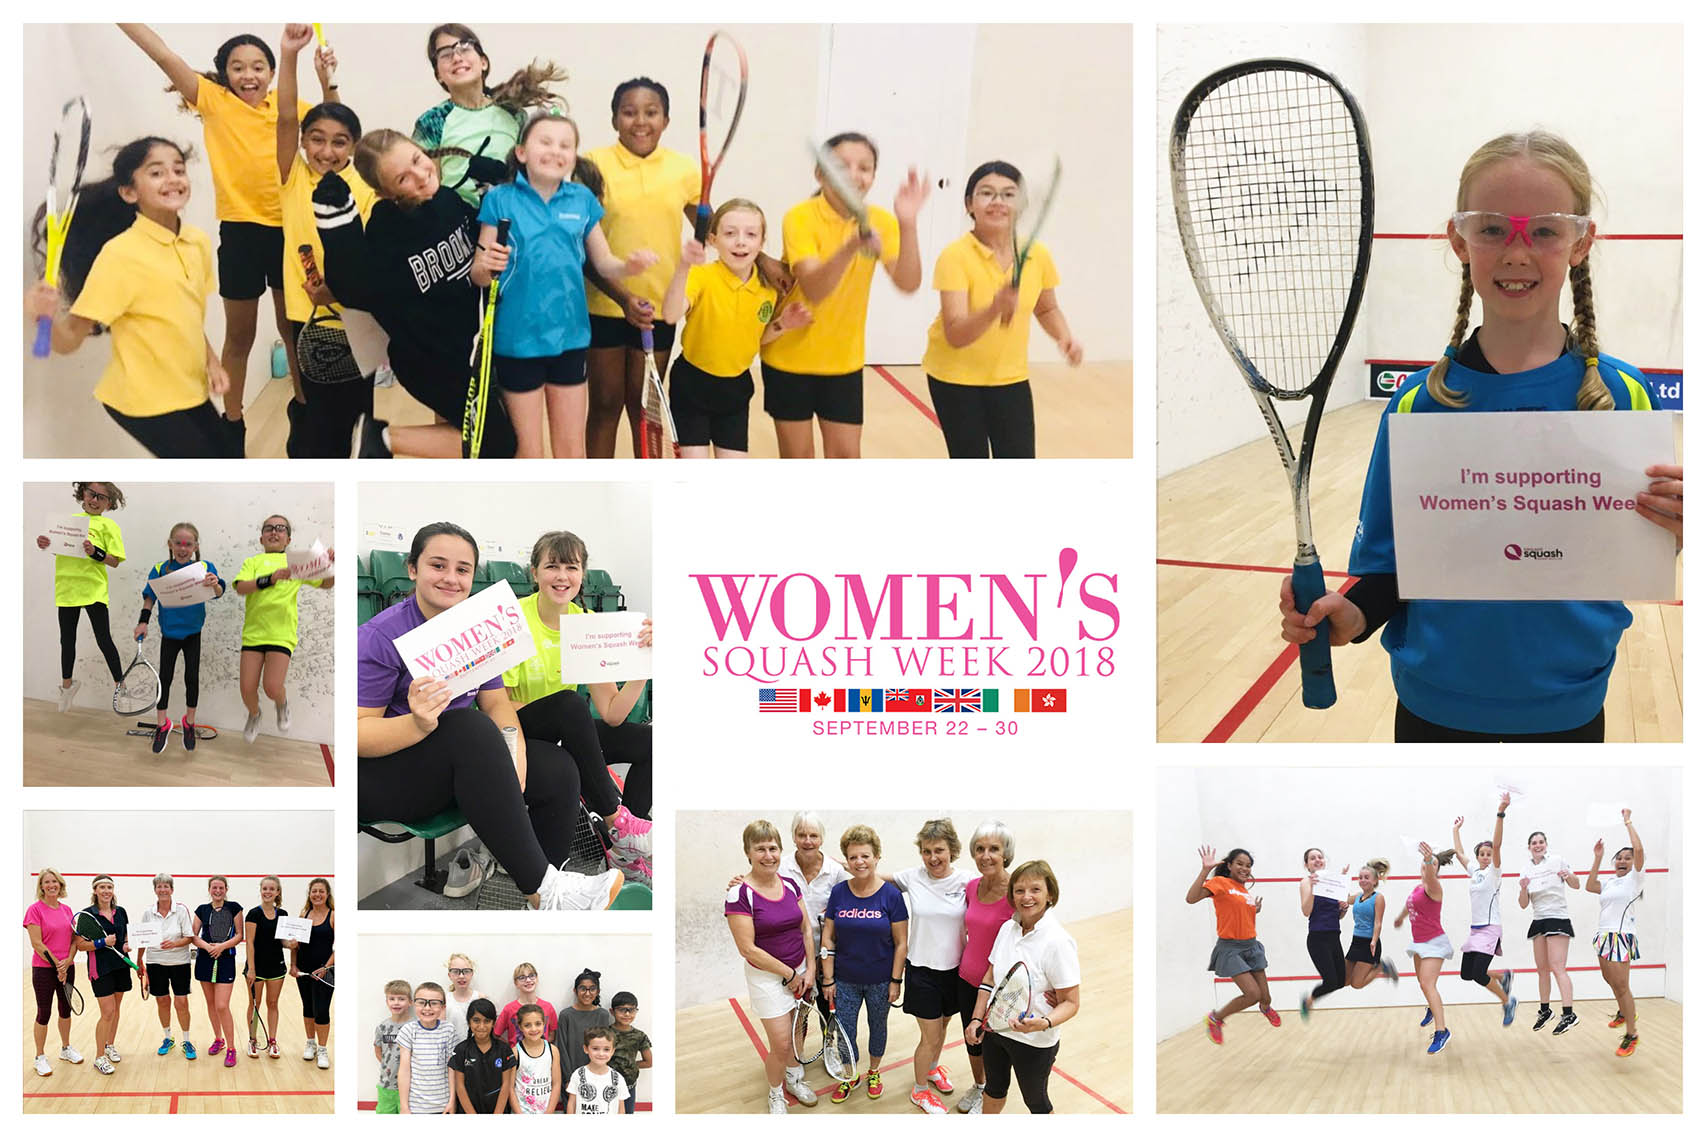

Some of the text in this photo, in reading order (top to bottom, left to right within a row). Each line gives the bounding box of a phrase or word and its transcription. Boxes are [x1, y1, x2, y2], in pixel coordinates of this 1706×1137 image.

[1650, 381, 1681, 399] td
[1258, 404, 1290, 469] DUNLOP
[1460, 468, 1602, 488] I'm supporting
[1419, 495, 1636, 514] Women's Squash Wee
[1523, 548, 1563, 560] squash
[414, 604, 520, 672] WOMEN'S
[431, 653, 471, 680] QUASH
[838, 908, 882, 919] adidas
